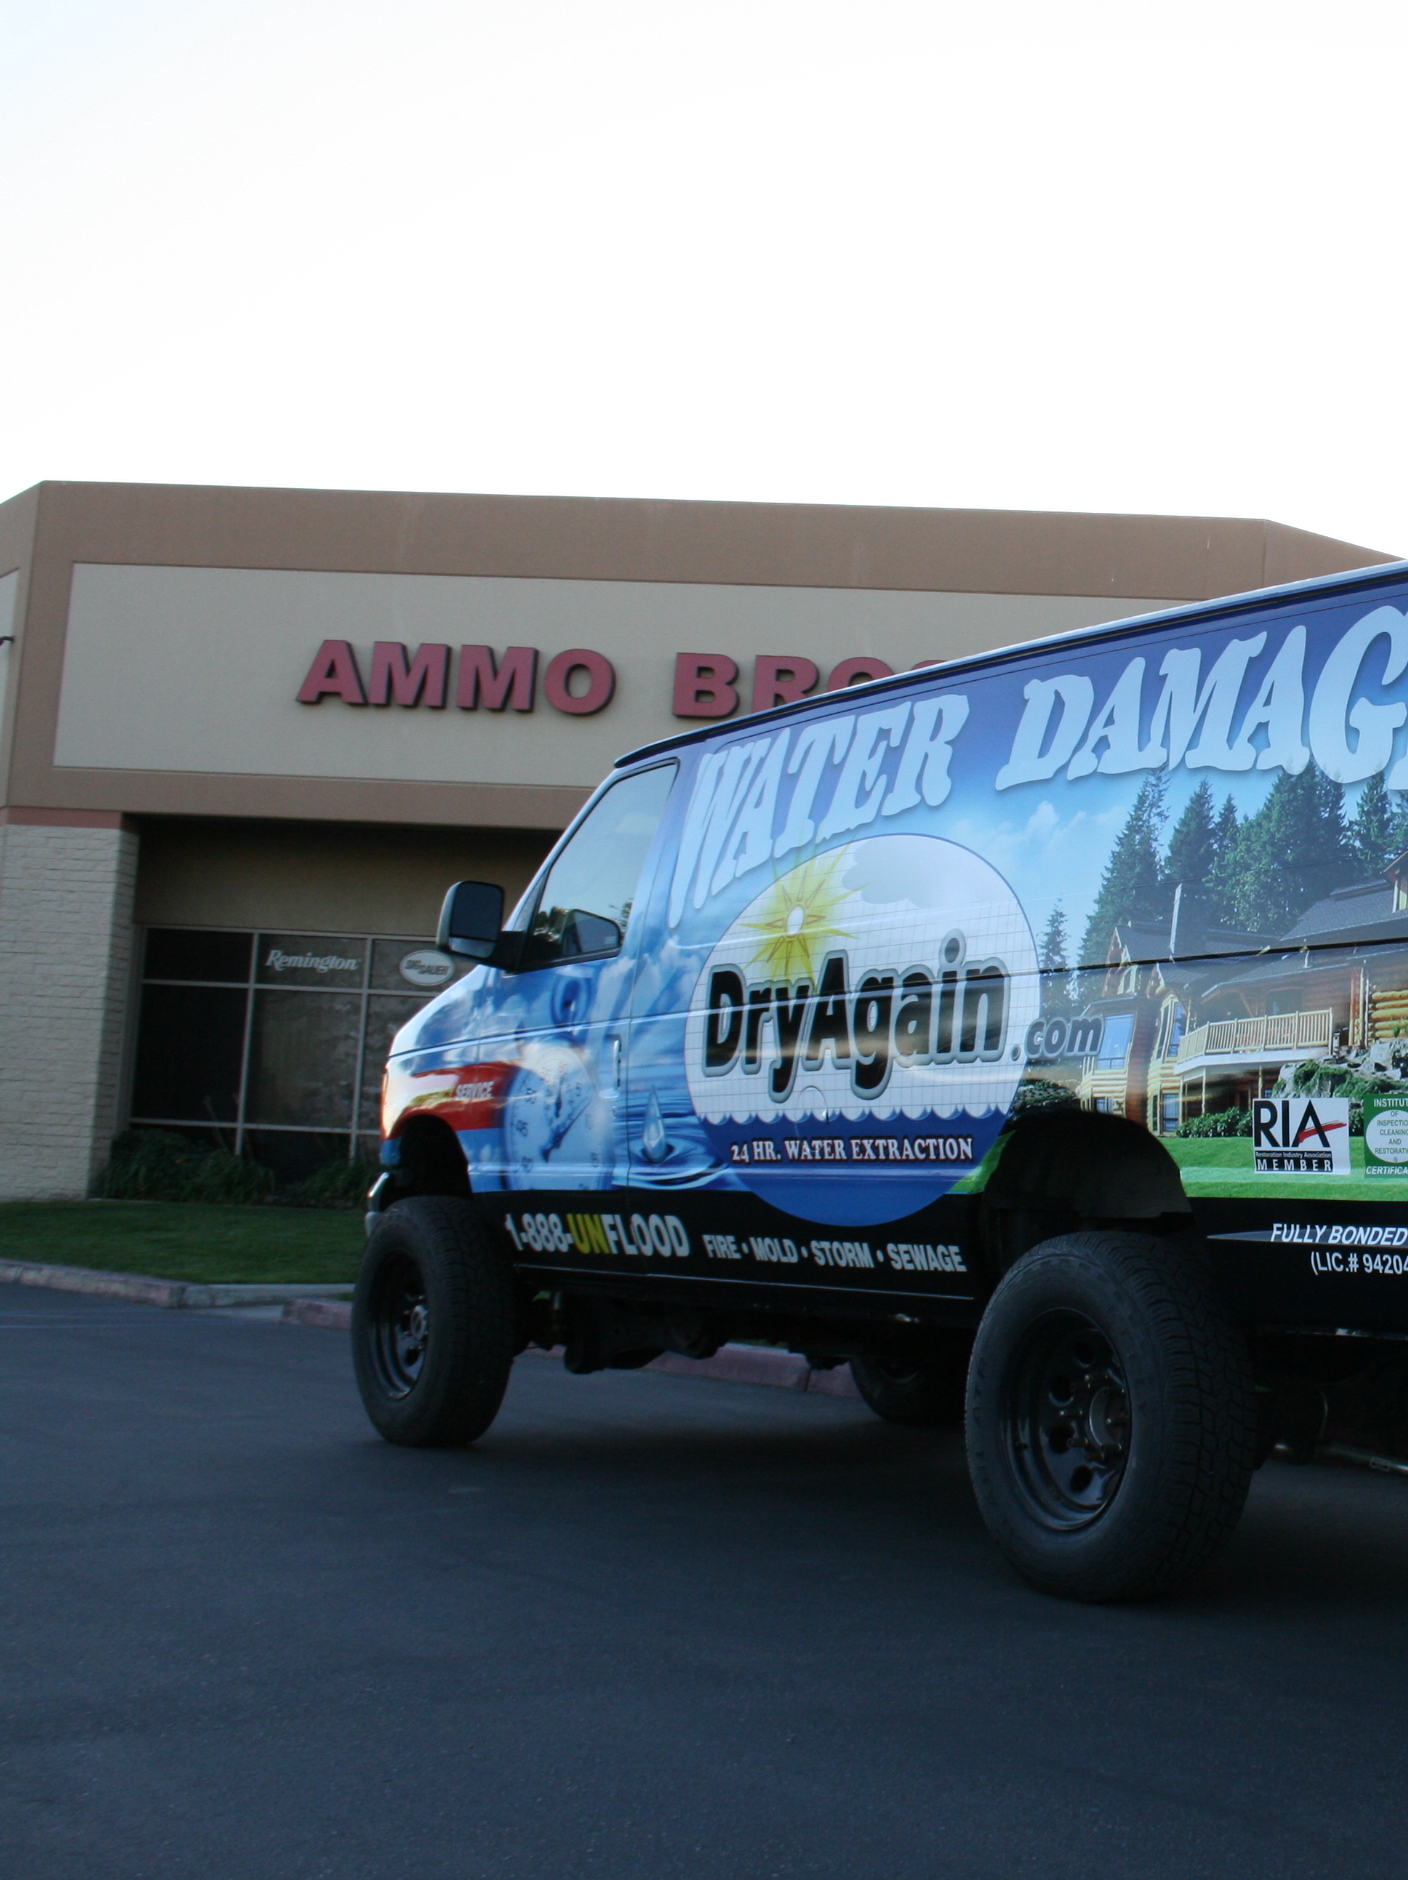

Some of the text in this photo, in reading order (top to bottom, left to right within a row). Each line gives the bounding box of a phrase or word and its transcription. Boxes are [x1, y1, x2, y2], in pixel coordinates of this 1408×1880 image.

[297, 639, 946, 718] AMMO BRO
[668, 694, 969, 929] WATER
[264, 949, 358, 973] Remington
[455, 1081, 495, 1099] SERVICE
[1254, 1100, 1331, 1148] RIA
[731, 1137, 973, 1163] 24 HR. WATER EXTRACTION
[1257, 1160, 1331, 1171] MEMBER
[505, 1213, 690, 1257] 1-888-UNFLOOD
[1270, 1223, 1326, 1242] FULLY
[1329, 1226, 1408, 1246] BONDED
[702, 1234, 967, 1272] FIRE MOLD STORM SEWAGE
